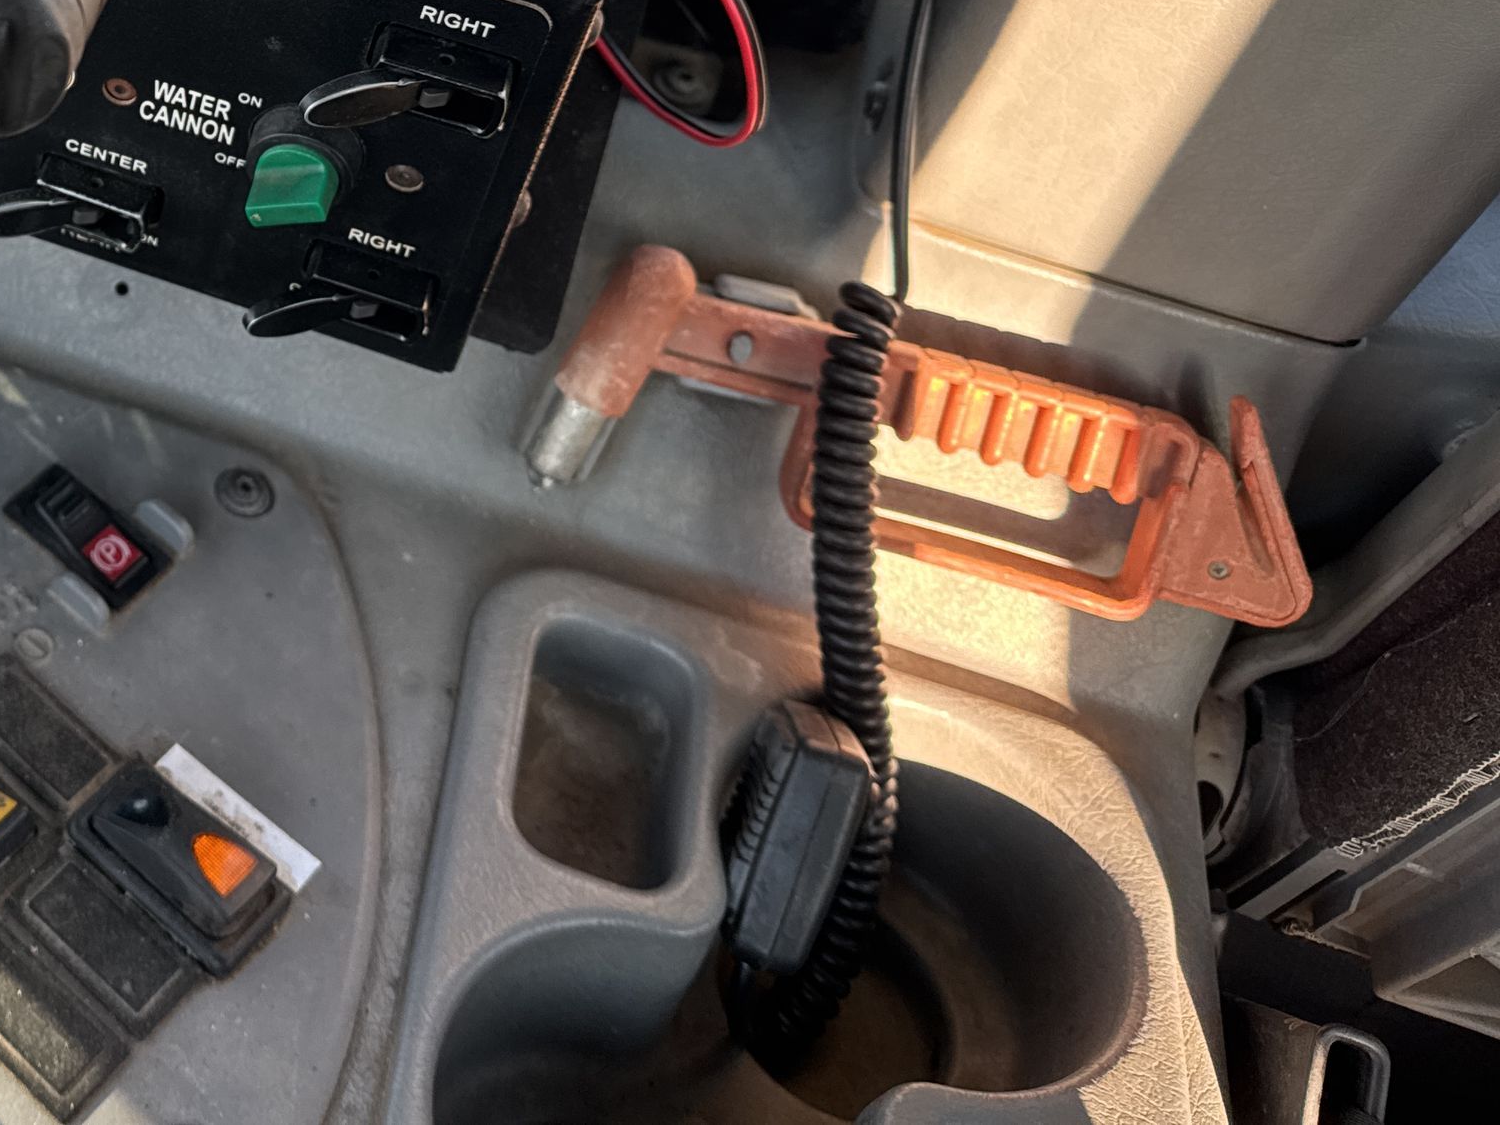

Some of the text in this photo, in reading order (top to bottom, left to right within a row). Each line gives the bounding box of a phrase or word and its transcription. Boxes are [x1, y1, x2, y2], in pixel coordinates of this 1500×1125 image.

[419, 5, 496, 38] RIGHT
[153, 79, 231, 121] WATER
[238, 92, 263, 108] ON
[139, 100, 235, 146] CANNON
[65, 138, 148, 175] CENTER
[214, 152, 247, 169] OFF
[348, 228, 416, 258] RIGHT
